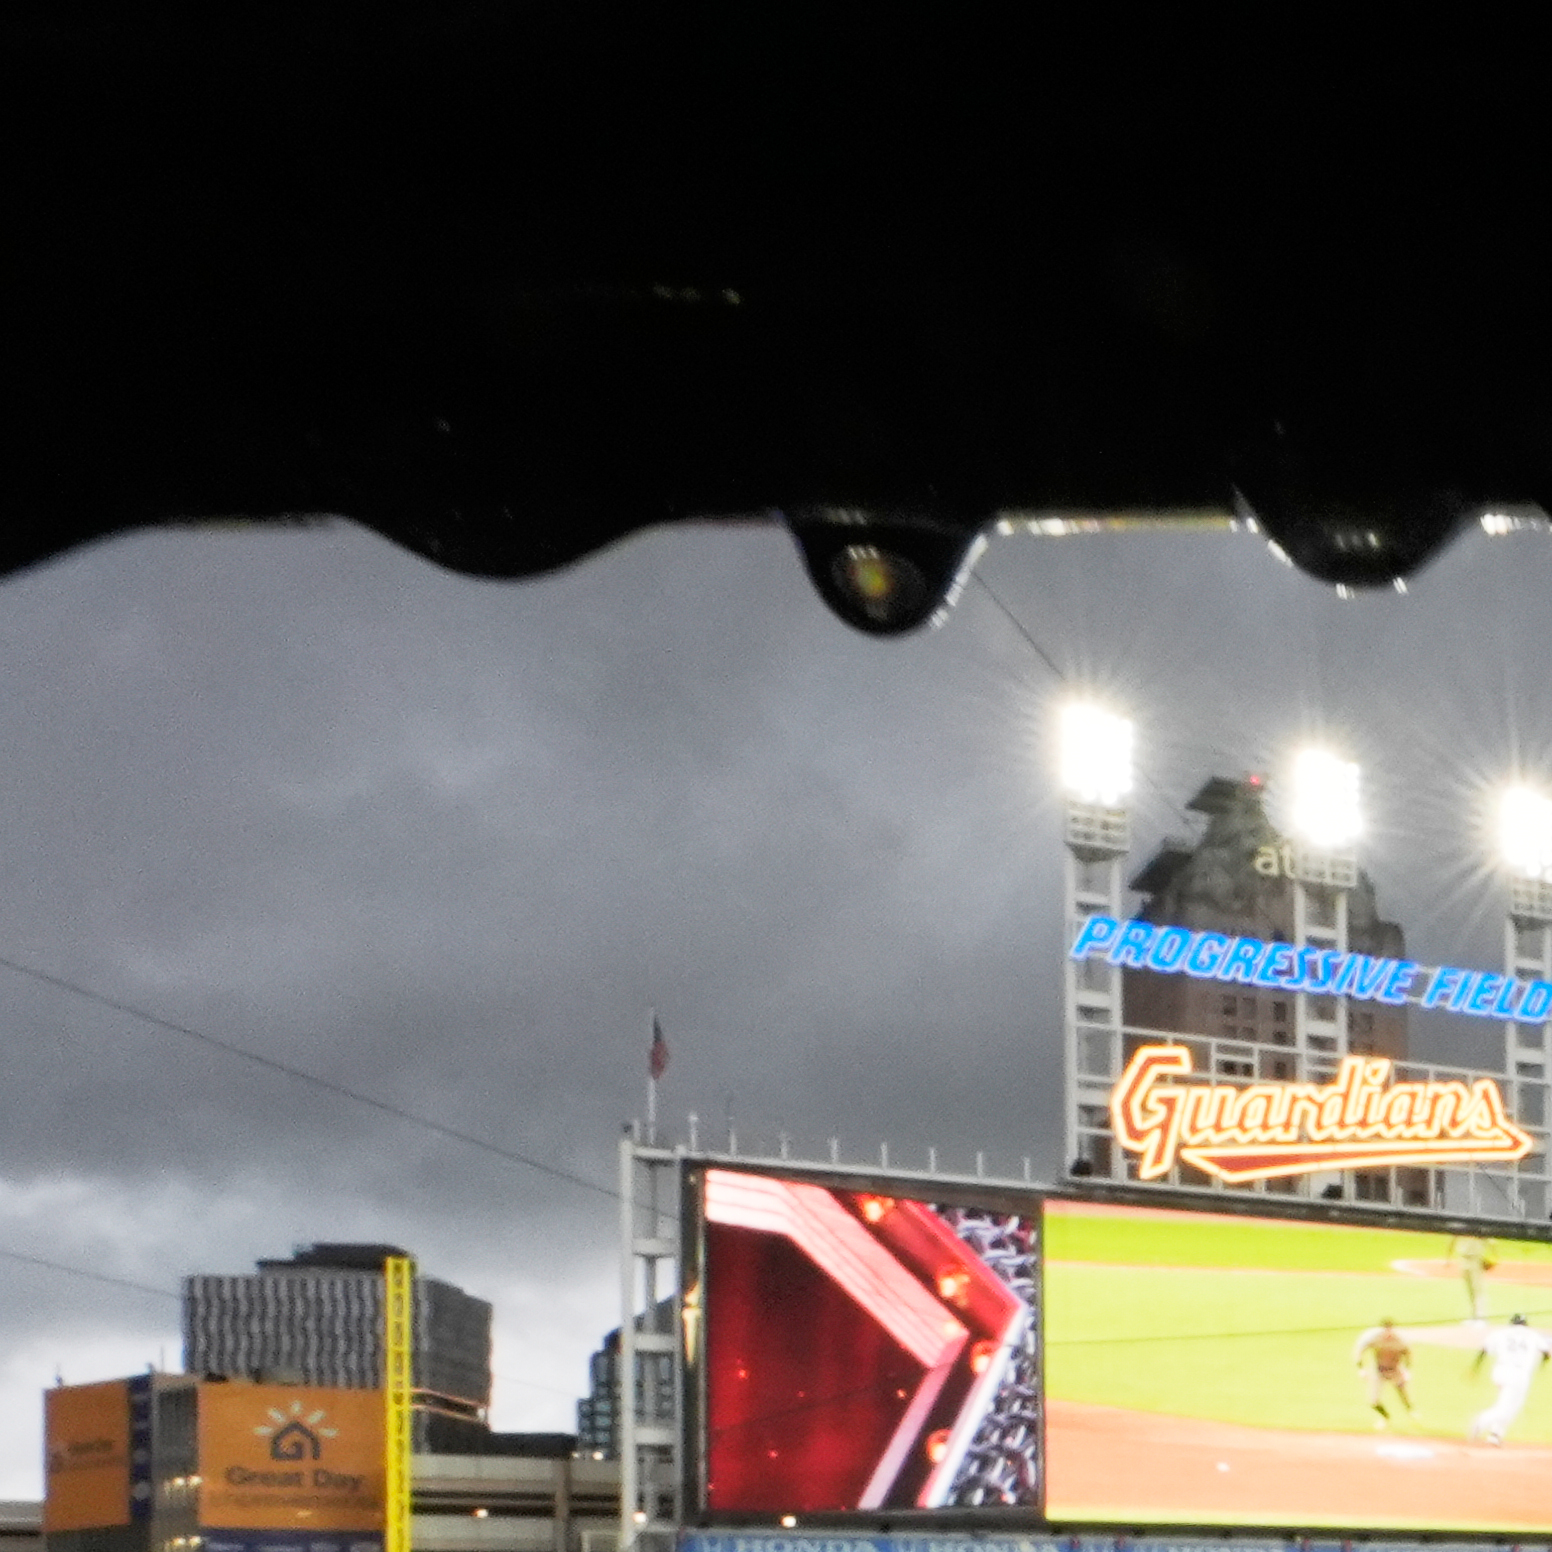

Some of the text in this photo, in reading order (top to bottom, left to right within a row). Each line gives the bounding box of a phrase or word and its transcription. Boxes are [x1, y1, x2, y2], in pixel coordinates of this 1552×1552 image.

[1070, 914, 1420, 1006] PROGRESSIVE
[1110, 1044, 1536, 1183] Guardians
[225, 1465, 364, 1493] Great Day
